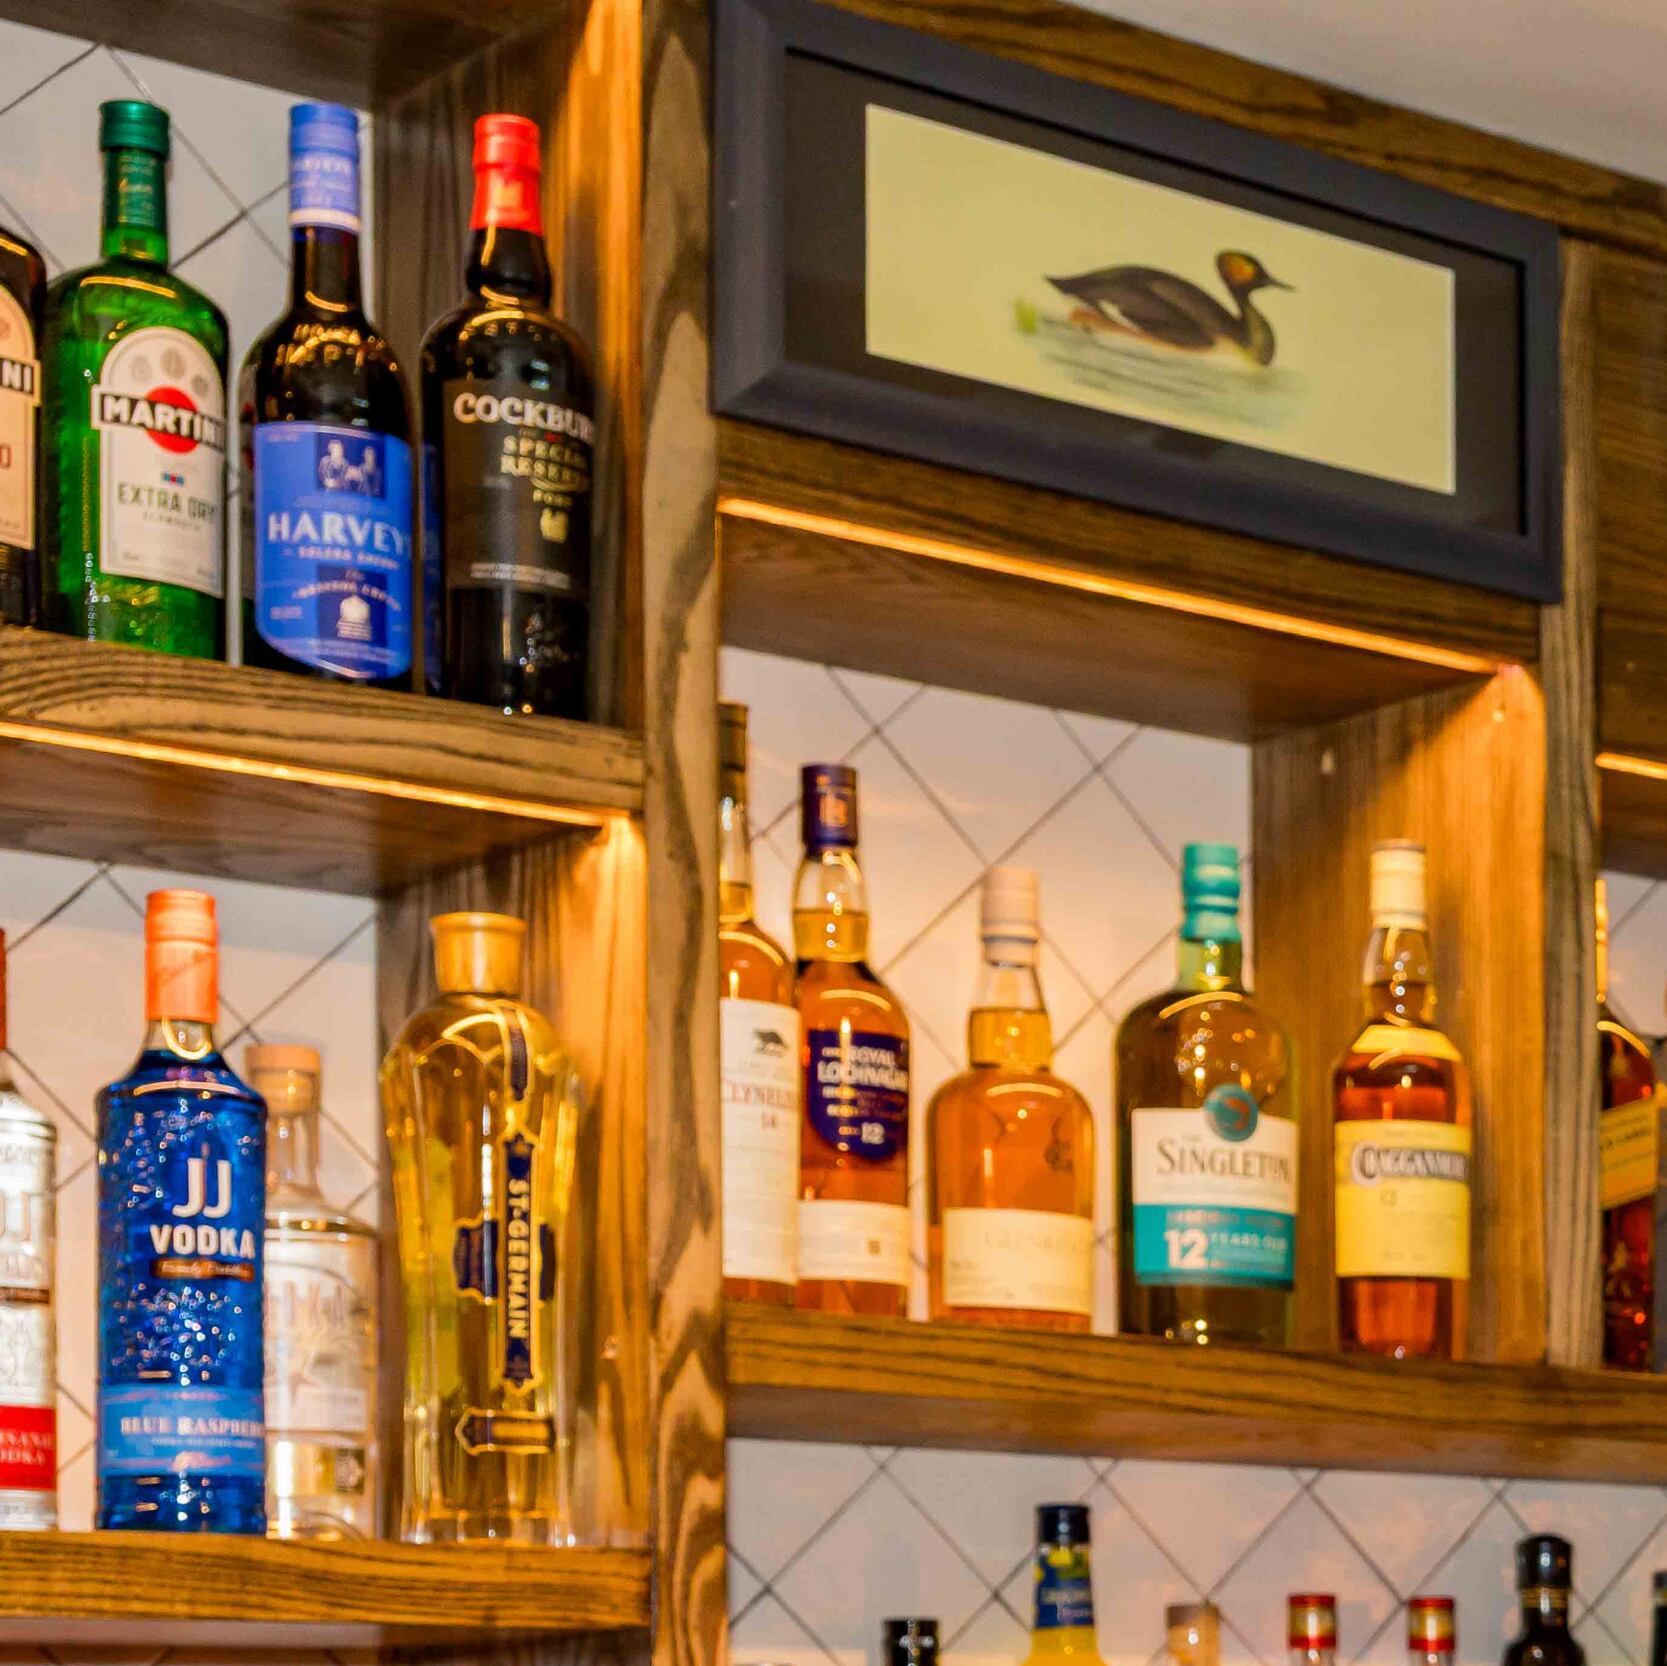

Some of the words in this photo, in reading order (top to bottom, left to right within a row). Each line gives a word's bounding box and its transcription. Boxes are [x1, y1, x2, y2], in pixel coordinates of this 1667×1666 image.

[117, 482, 181, 513] EXTRA
[171, 1157, 232, 1219] JJ
[150, 1224, 256, 1260] VODKA
[1164, 1228, 1208, 1270] 12
